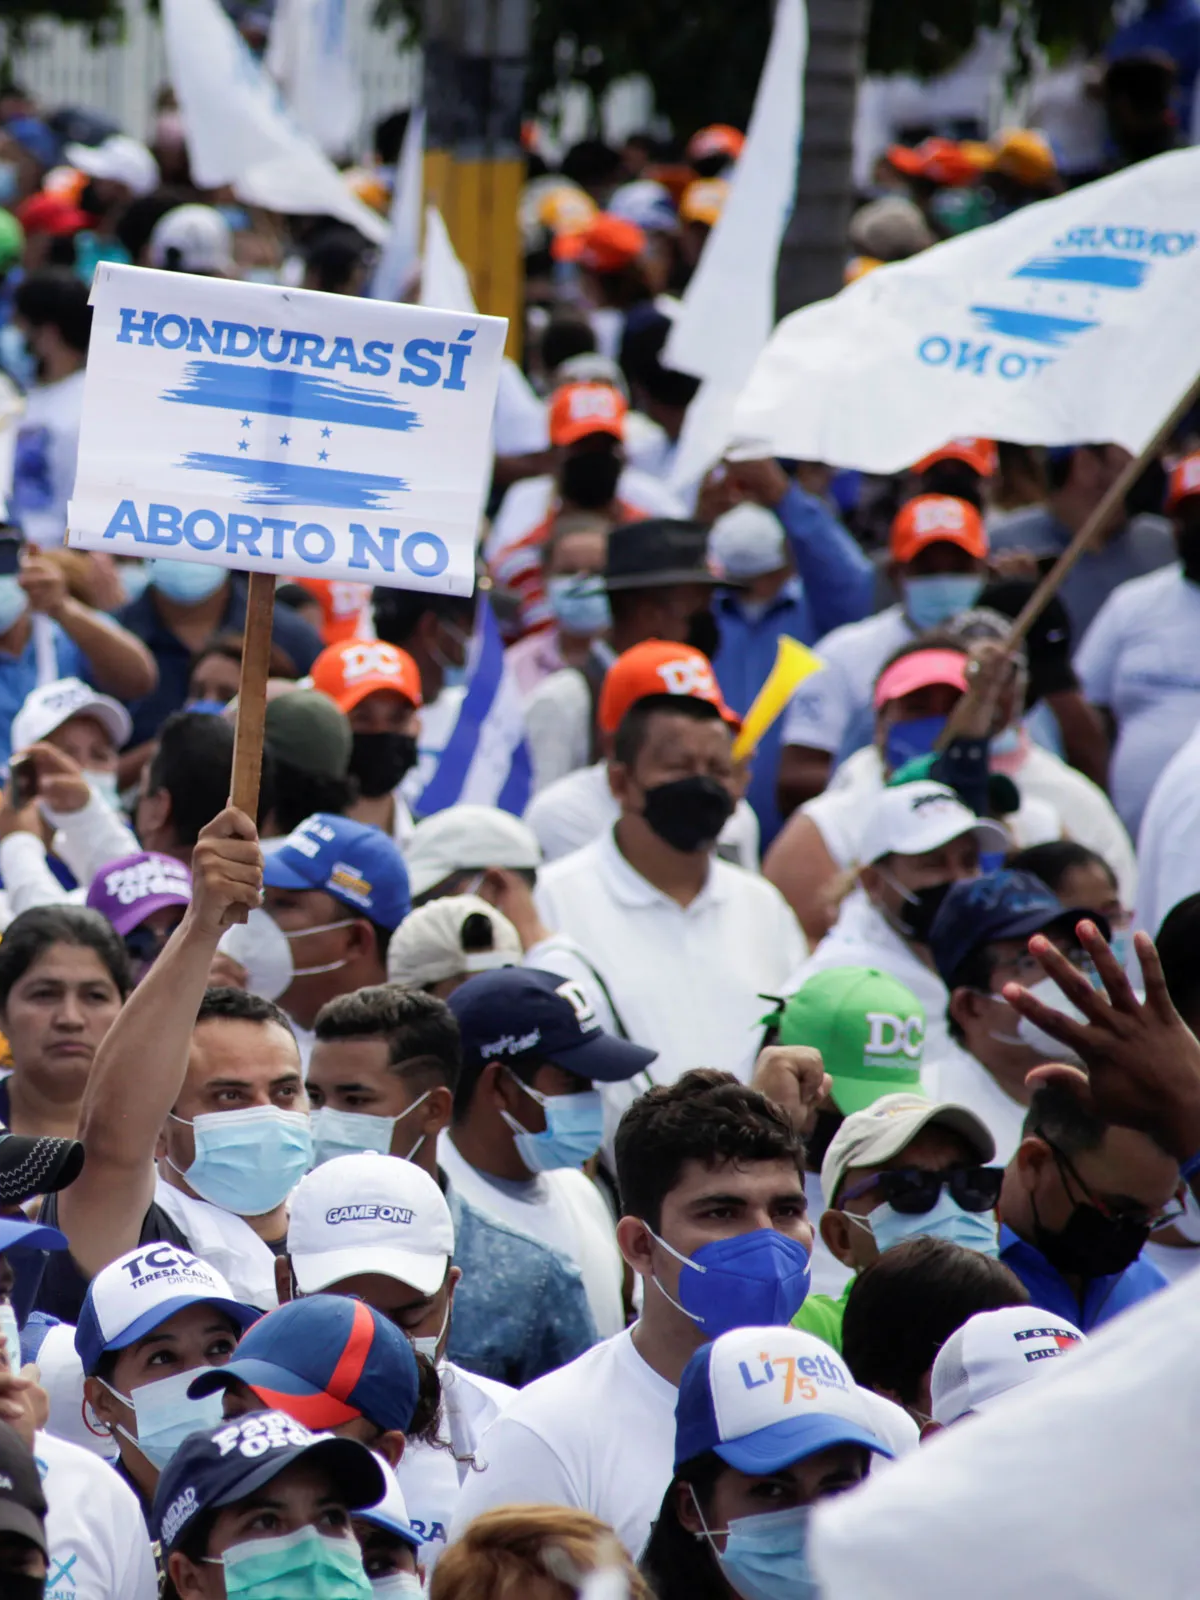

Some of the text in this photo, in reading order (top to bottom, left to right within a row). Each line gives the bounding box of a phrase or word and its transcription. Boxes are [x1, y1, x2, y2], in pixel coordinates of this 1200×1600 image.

[116, 307, 473, 391] HONDURAS SÍ
[103, 499, 450, 579] ABORTO NO
[341, 644, 400, 676] DC
[656, 655, 713, 695] DC
[864, 1011, 922, 1058] DC
[326, 1204, 414, 1225] GAME ON!
[130, 1268, 180, 1289] TERESA
[1019, 1328, 1079, 1340] TOMMY
